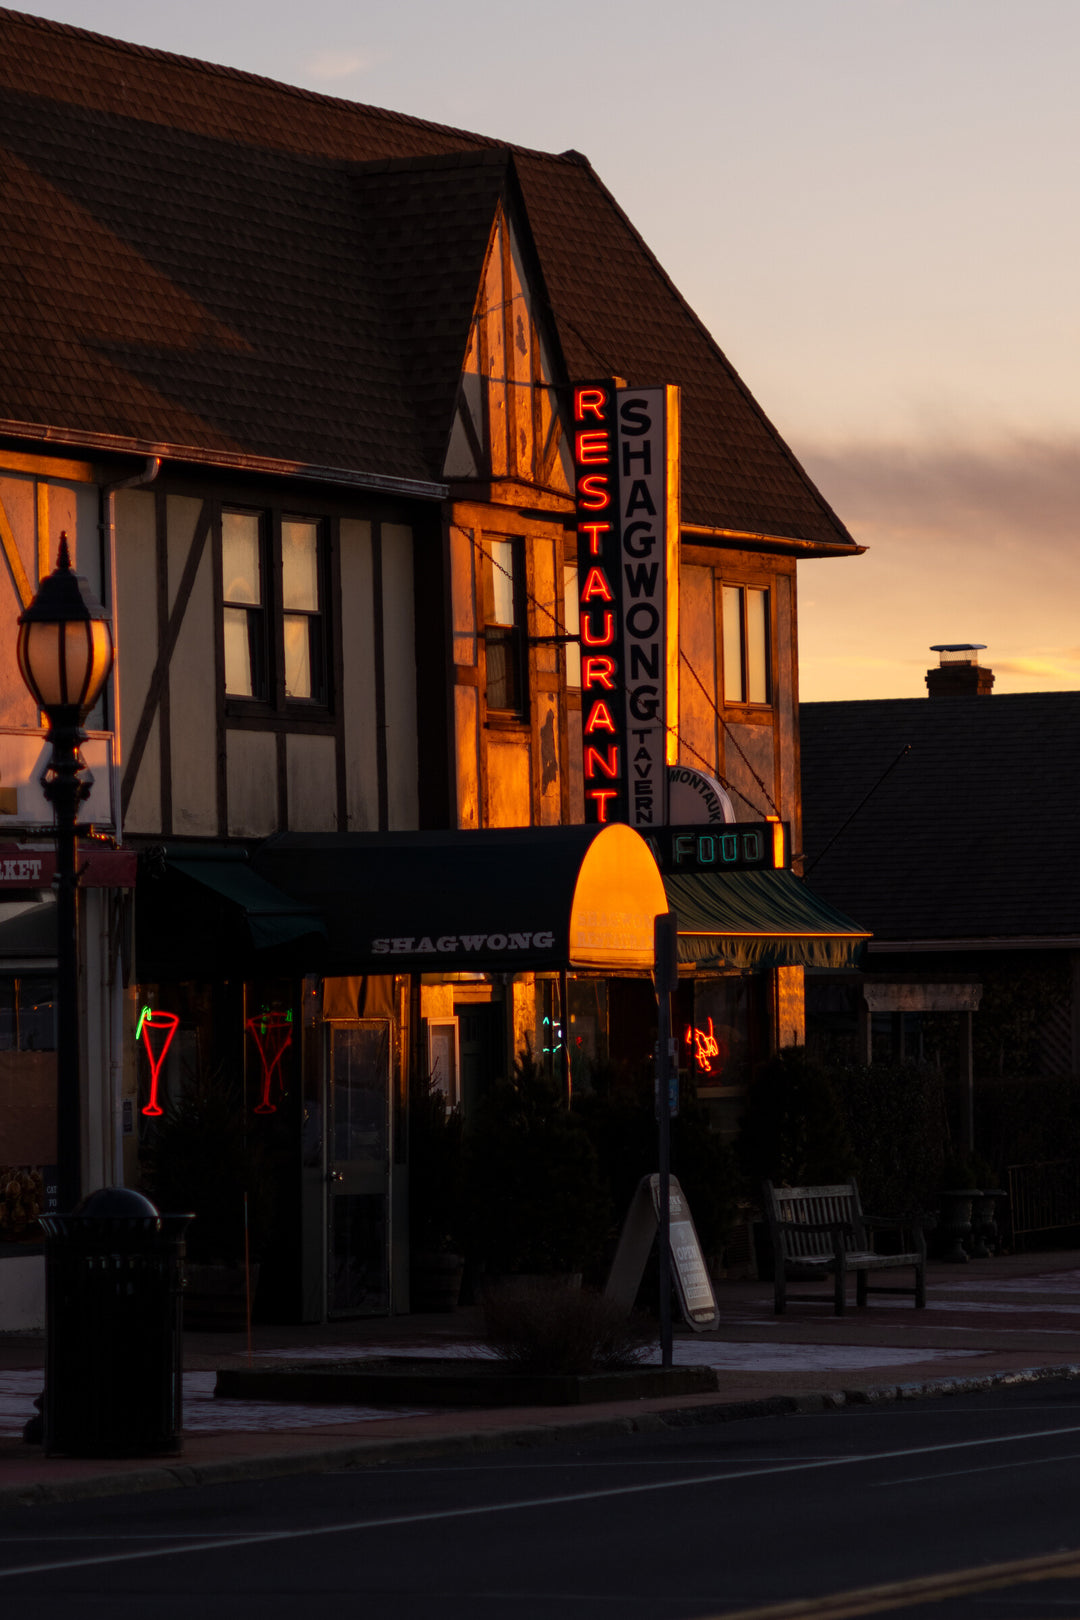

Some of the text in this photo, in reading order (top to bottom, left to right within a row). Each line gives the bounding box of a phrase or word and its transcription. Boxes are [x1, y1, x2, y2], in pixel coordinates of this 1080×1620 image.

[620, 399, 660, 721] SHAGWONG
[575, 387, 618, 822] RESTAURANT
[632, 729, 654, 824] TAVERN
[669, 769, 721, 823] MONTAUK
[672, 829, 765, 866] FOOD
[0, 860, 42, 880] KET
[576, 911, 654, 930] SHAGWON
[371, 931, 555, 955] SHAGWONG
[576, 931, 655, 950] RESTAURAN
